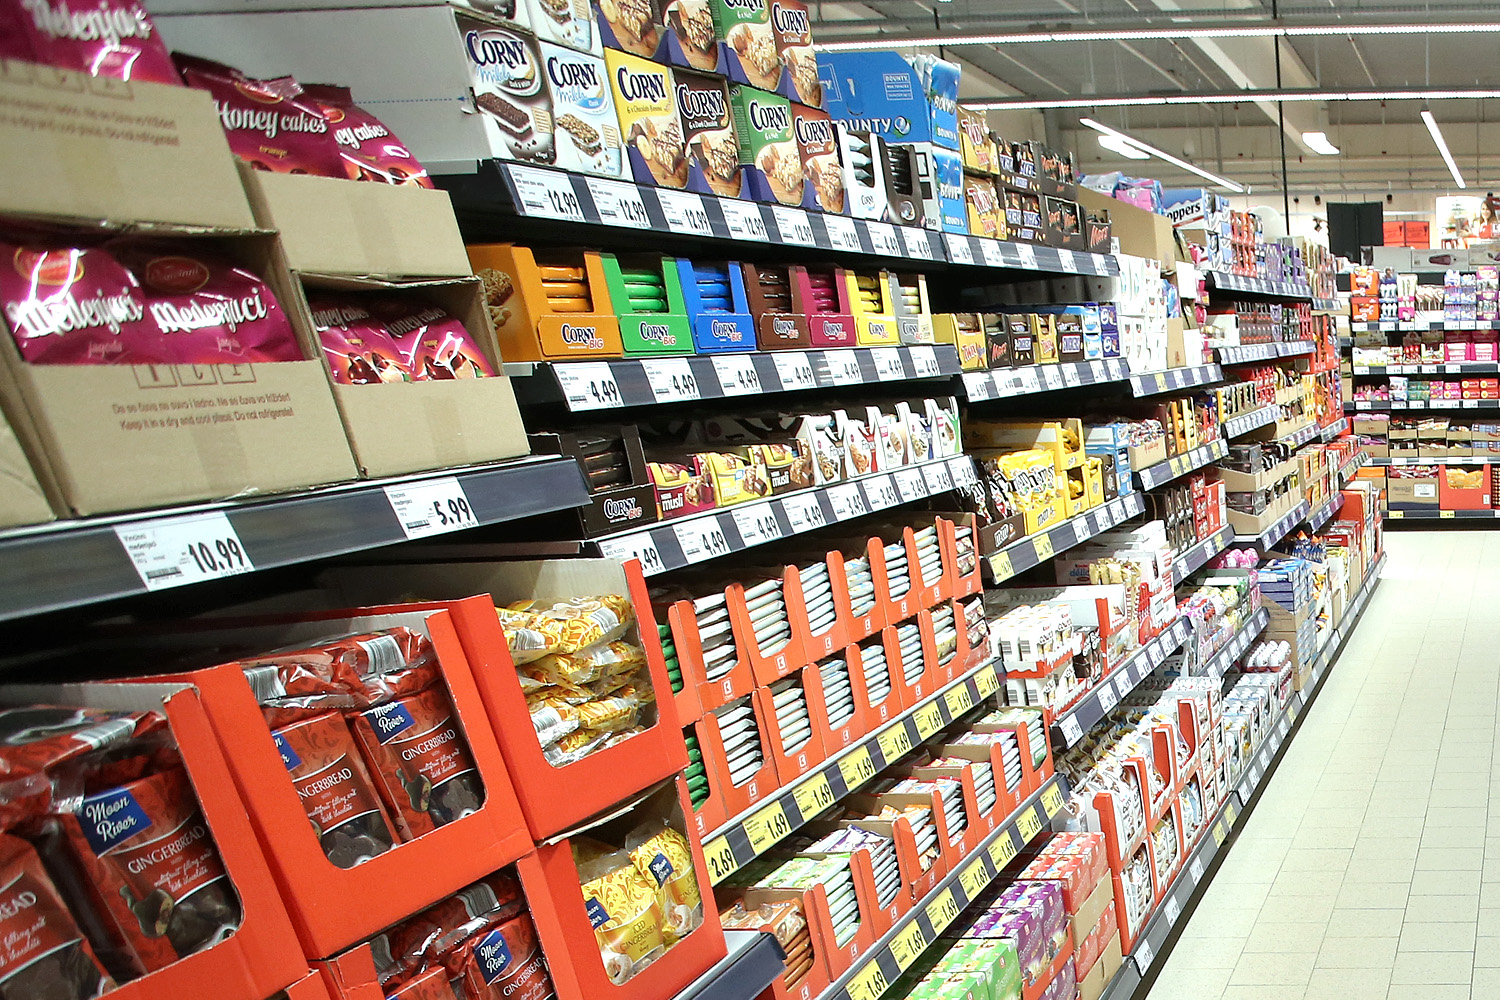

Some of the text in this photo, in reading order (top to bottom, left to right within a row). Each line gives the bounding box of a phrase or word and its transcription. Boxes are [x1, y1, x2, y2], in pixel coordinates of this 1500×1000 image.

[774, 2, 808, 35] CORNY
[466, 32, 528, 69] CORNY
[548, 57, 598, 89] CORNY
[618, 67, 667, 102] CORNY
[677, 84, 725, 120] CORNY
[281, 112, 328, 133] cakes
[750, 101, 789, 131] CORNY
[832, 117, 891, 135] OUNTY
[795, 117, 831, 144] CORNY
[548, 189, 580, 215] 12.99
[619, 198, 649, 221] 12.99
[685, 208, 709, 230] 12.99
[150, 288, 268, 334] Medenjaci
[561, 322, 604, 350] CORNY BIG
[639, 321, 676, 346] CORNY BIG
[711, 319, 737, 339] CORNY
[590, 380, 618, 403] 4.49
[672, 374, 696, 395] 4.49
[738, 370, 758, 389] 4.49
[434, 497, 473, 526] 5.99
[603, 497, 636, 518] CORNY
[662, 496, 684, 511] musli
[756, 516, 779, 538] 4.49
[188, 538, 245, 574] 10.99
[702, 531, 726, 557] 4.49
[377, 711, 406, 733] River
[401, 729, 457, 761] GINGERBREAD
[813, 783, 832, 805] 1.69
[86, 796, 130, 823] Moon
[96, 814, 138, 842] River
[769, 819, 788, 842] 1.69
[127, 823, 205, 876] GINGERBREAD
[711, 848, 735, 877] 2.69
[480, 941, 505, 961] Moon
[487, 953, 507, 974] River
[502, 956, 544, 999] GINGERBREAD
[866, 969, 886, 995] 1.69
